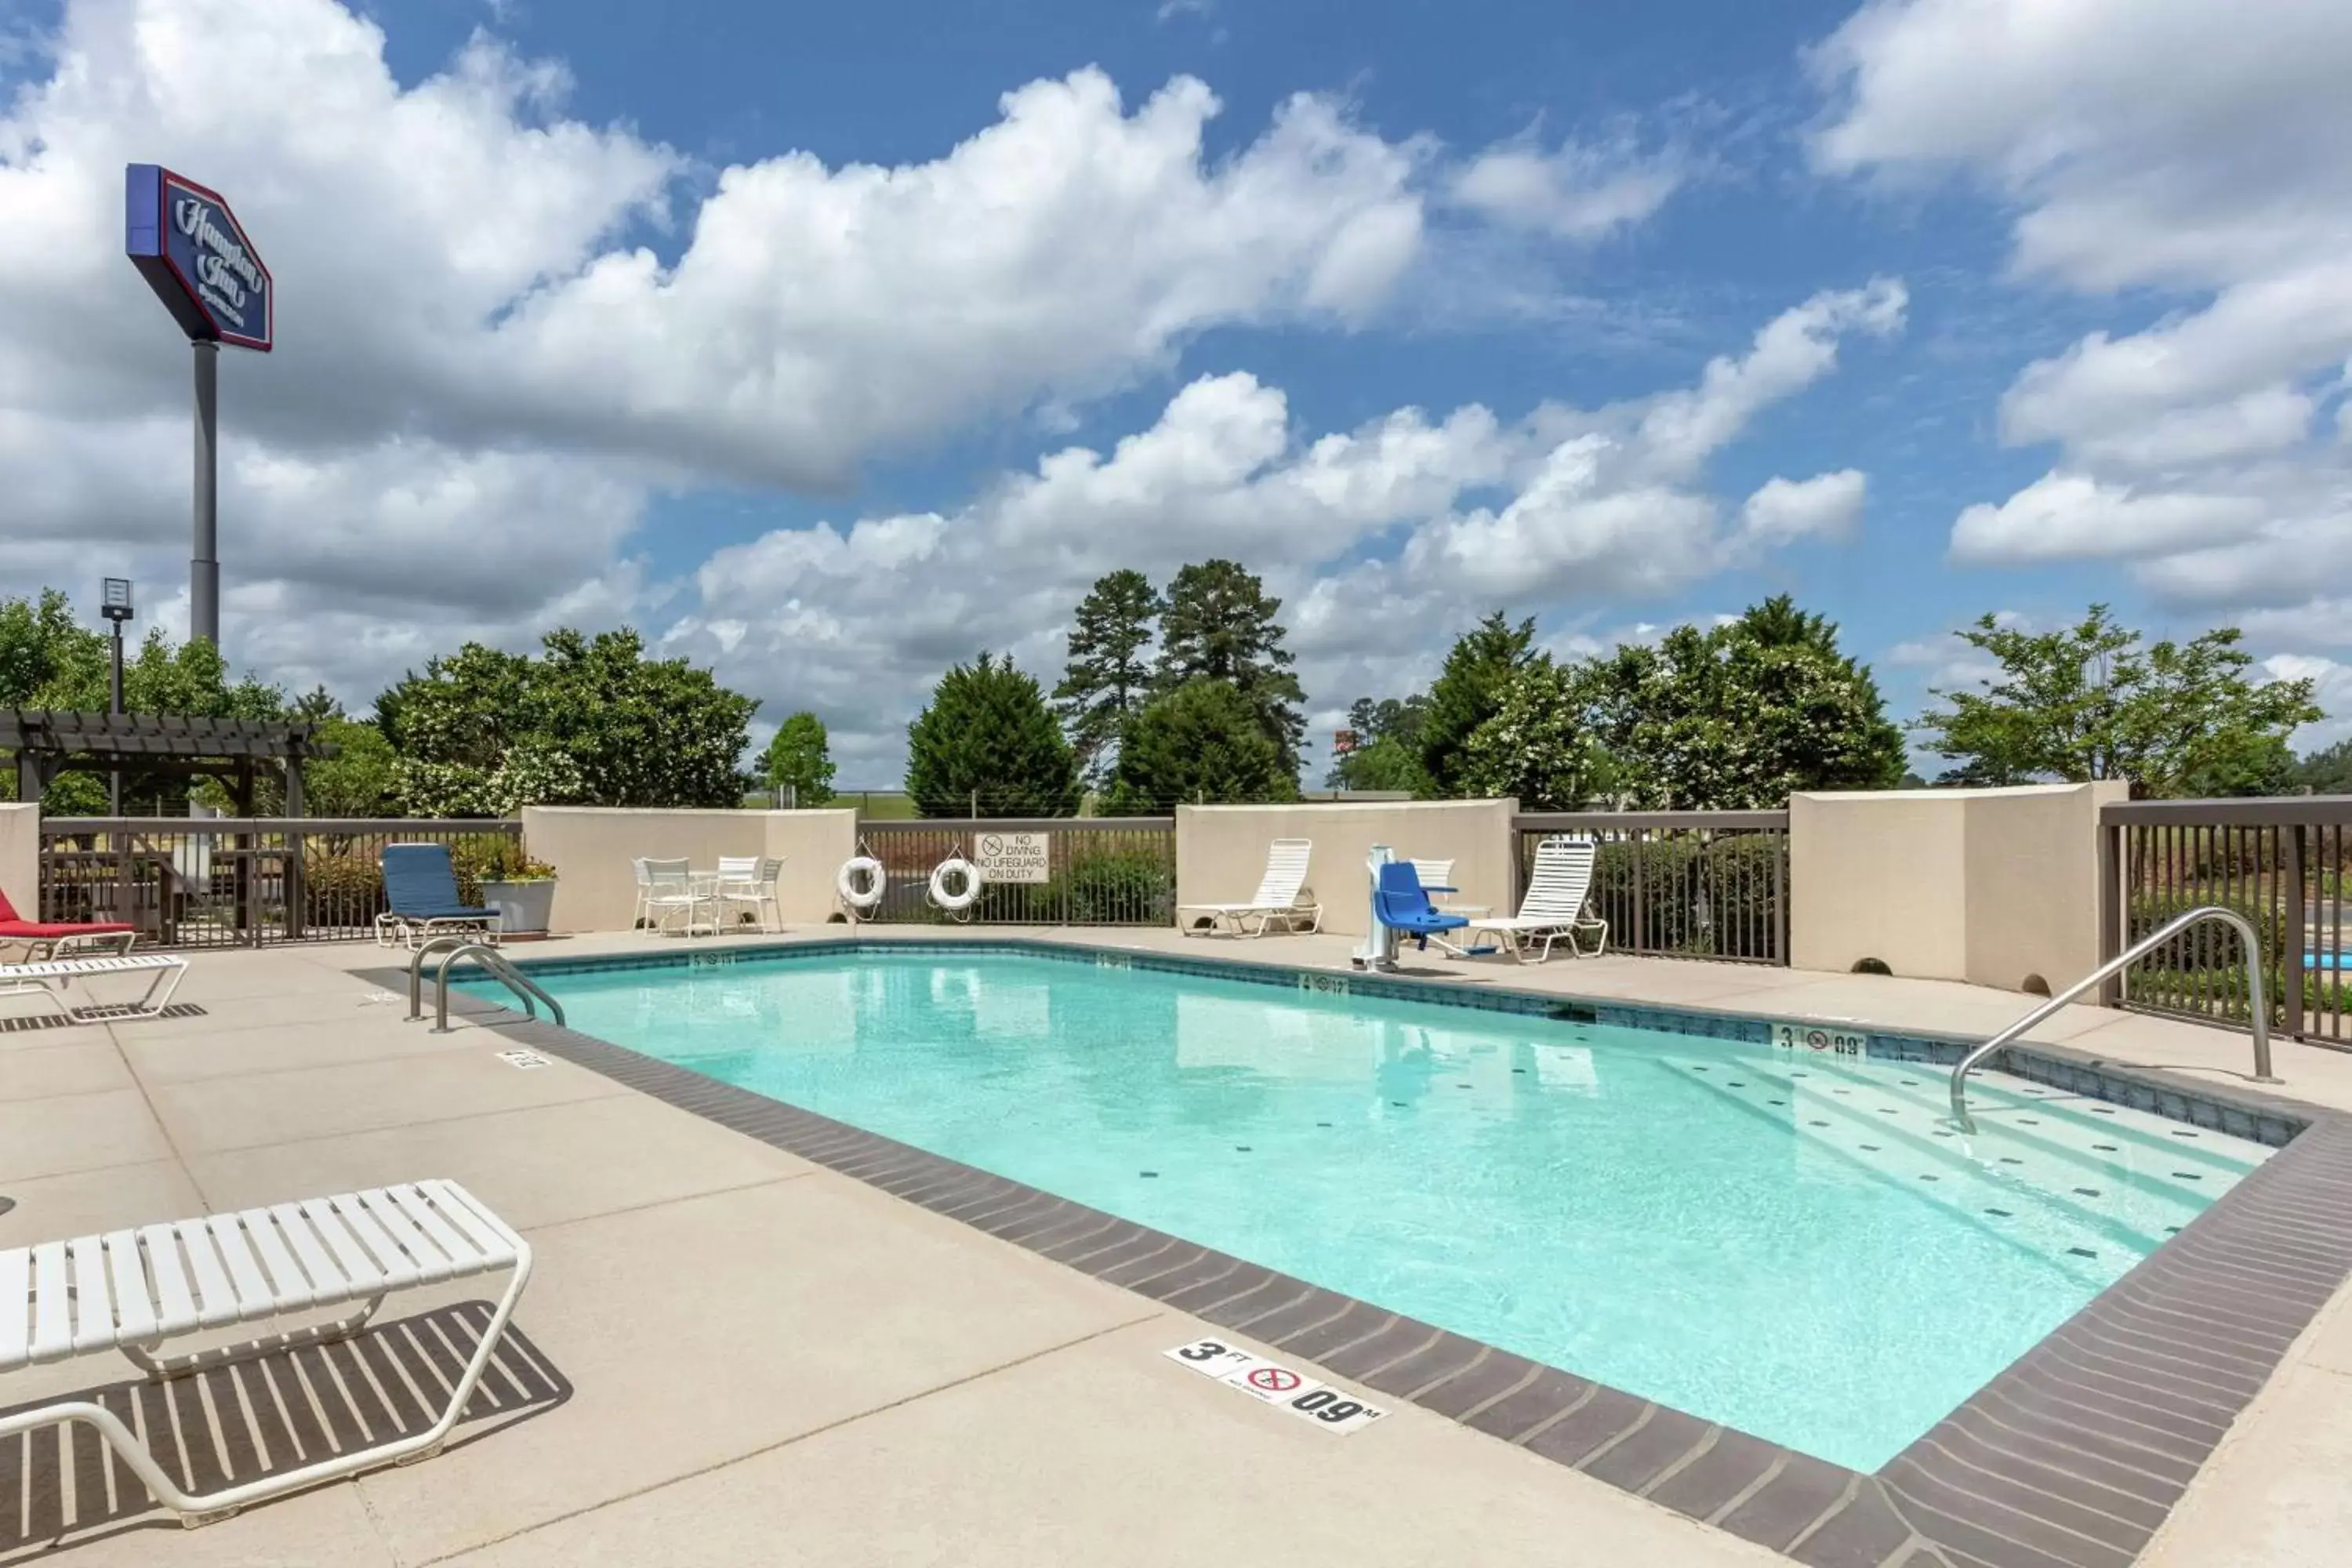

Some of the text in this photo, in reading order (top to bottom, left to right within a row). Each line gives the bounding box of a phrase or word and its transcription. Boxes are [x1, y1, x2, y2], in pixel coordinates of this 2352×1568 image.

[1015, 835, 1031, 845] NO
[1006, 846, 1041, 855] DIVING
[976, 858, 1046, 868] NO LIFEGUARD
[989, 869, 1033, 879] ON DUTY
[1781, 1027, 1793, 1047] 3
[1178, 1342, 1227, 1362] 3
[1226, 1351, 1253, 1363] FT
